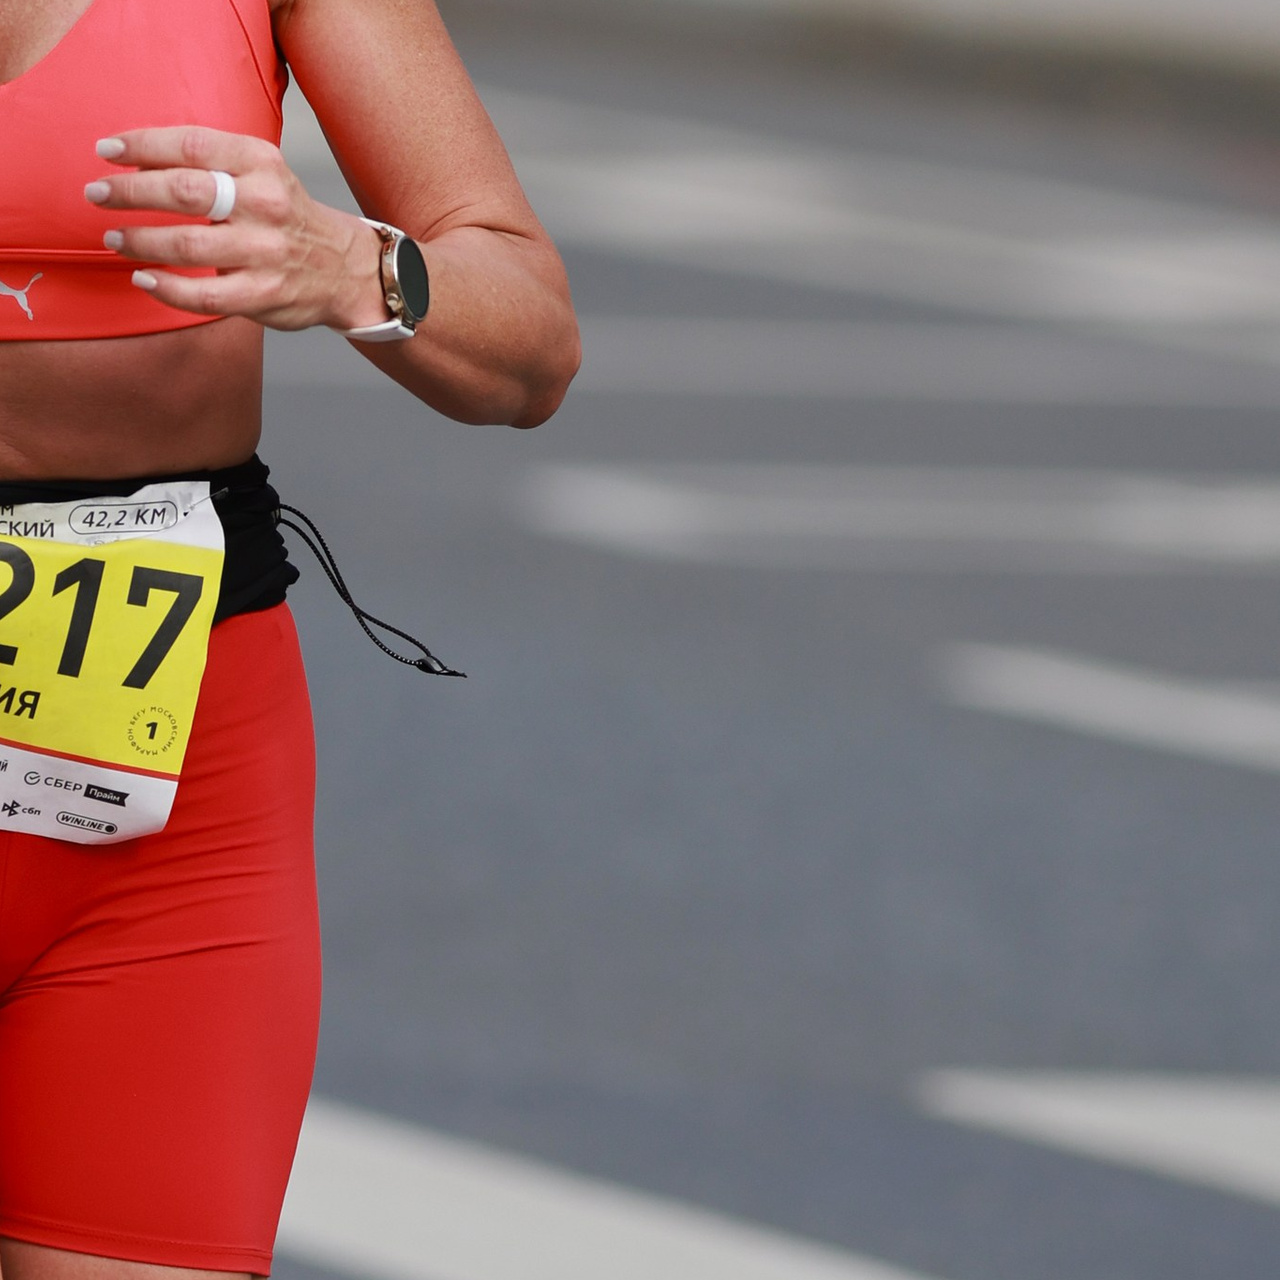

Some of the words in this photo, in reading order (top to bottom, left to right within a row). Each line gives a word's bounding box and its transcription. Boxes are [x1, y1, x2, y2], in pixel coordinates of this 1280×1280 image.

[82, 509, 128, 529] 42,2
[130, 708, 146, 726] БЕГУ
[146, 721, 159, 740] 1
[150, 706, 178, 752] МОСКОВСКИЙ
[127, 728, 158, 756] МАРАФОН
[44, 776, 83, 792] СБЕР
[88, 787, 121, 802] Прайм
[21, 807, 41, 816] сбп
[60, 813, 103, 831] WINLINE
